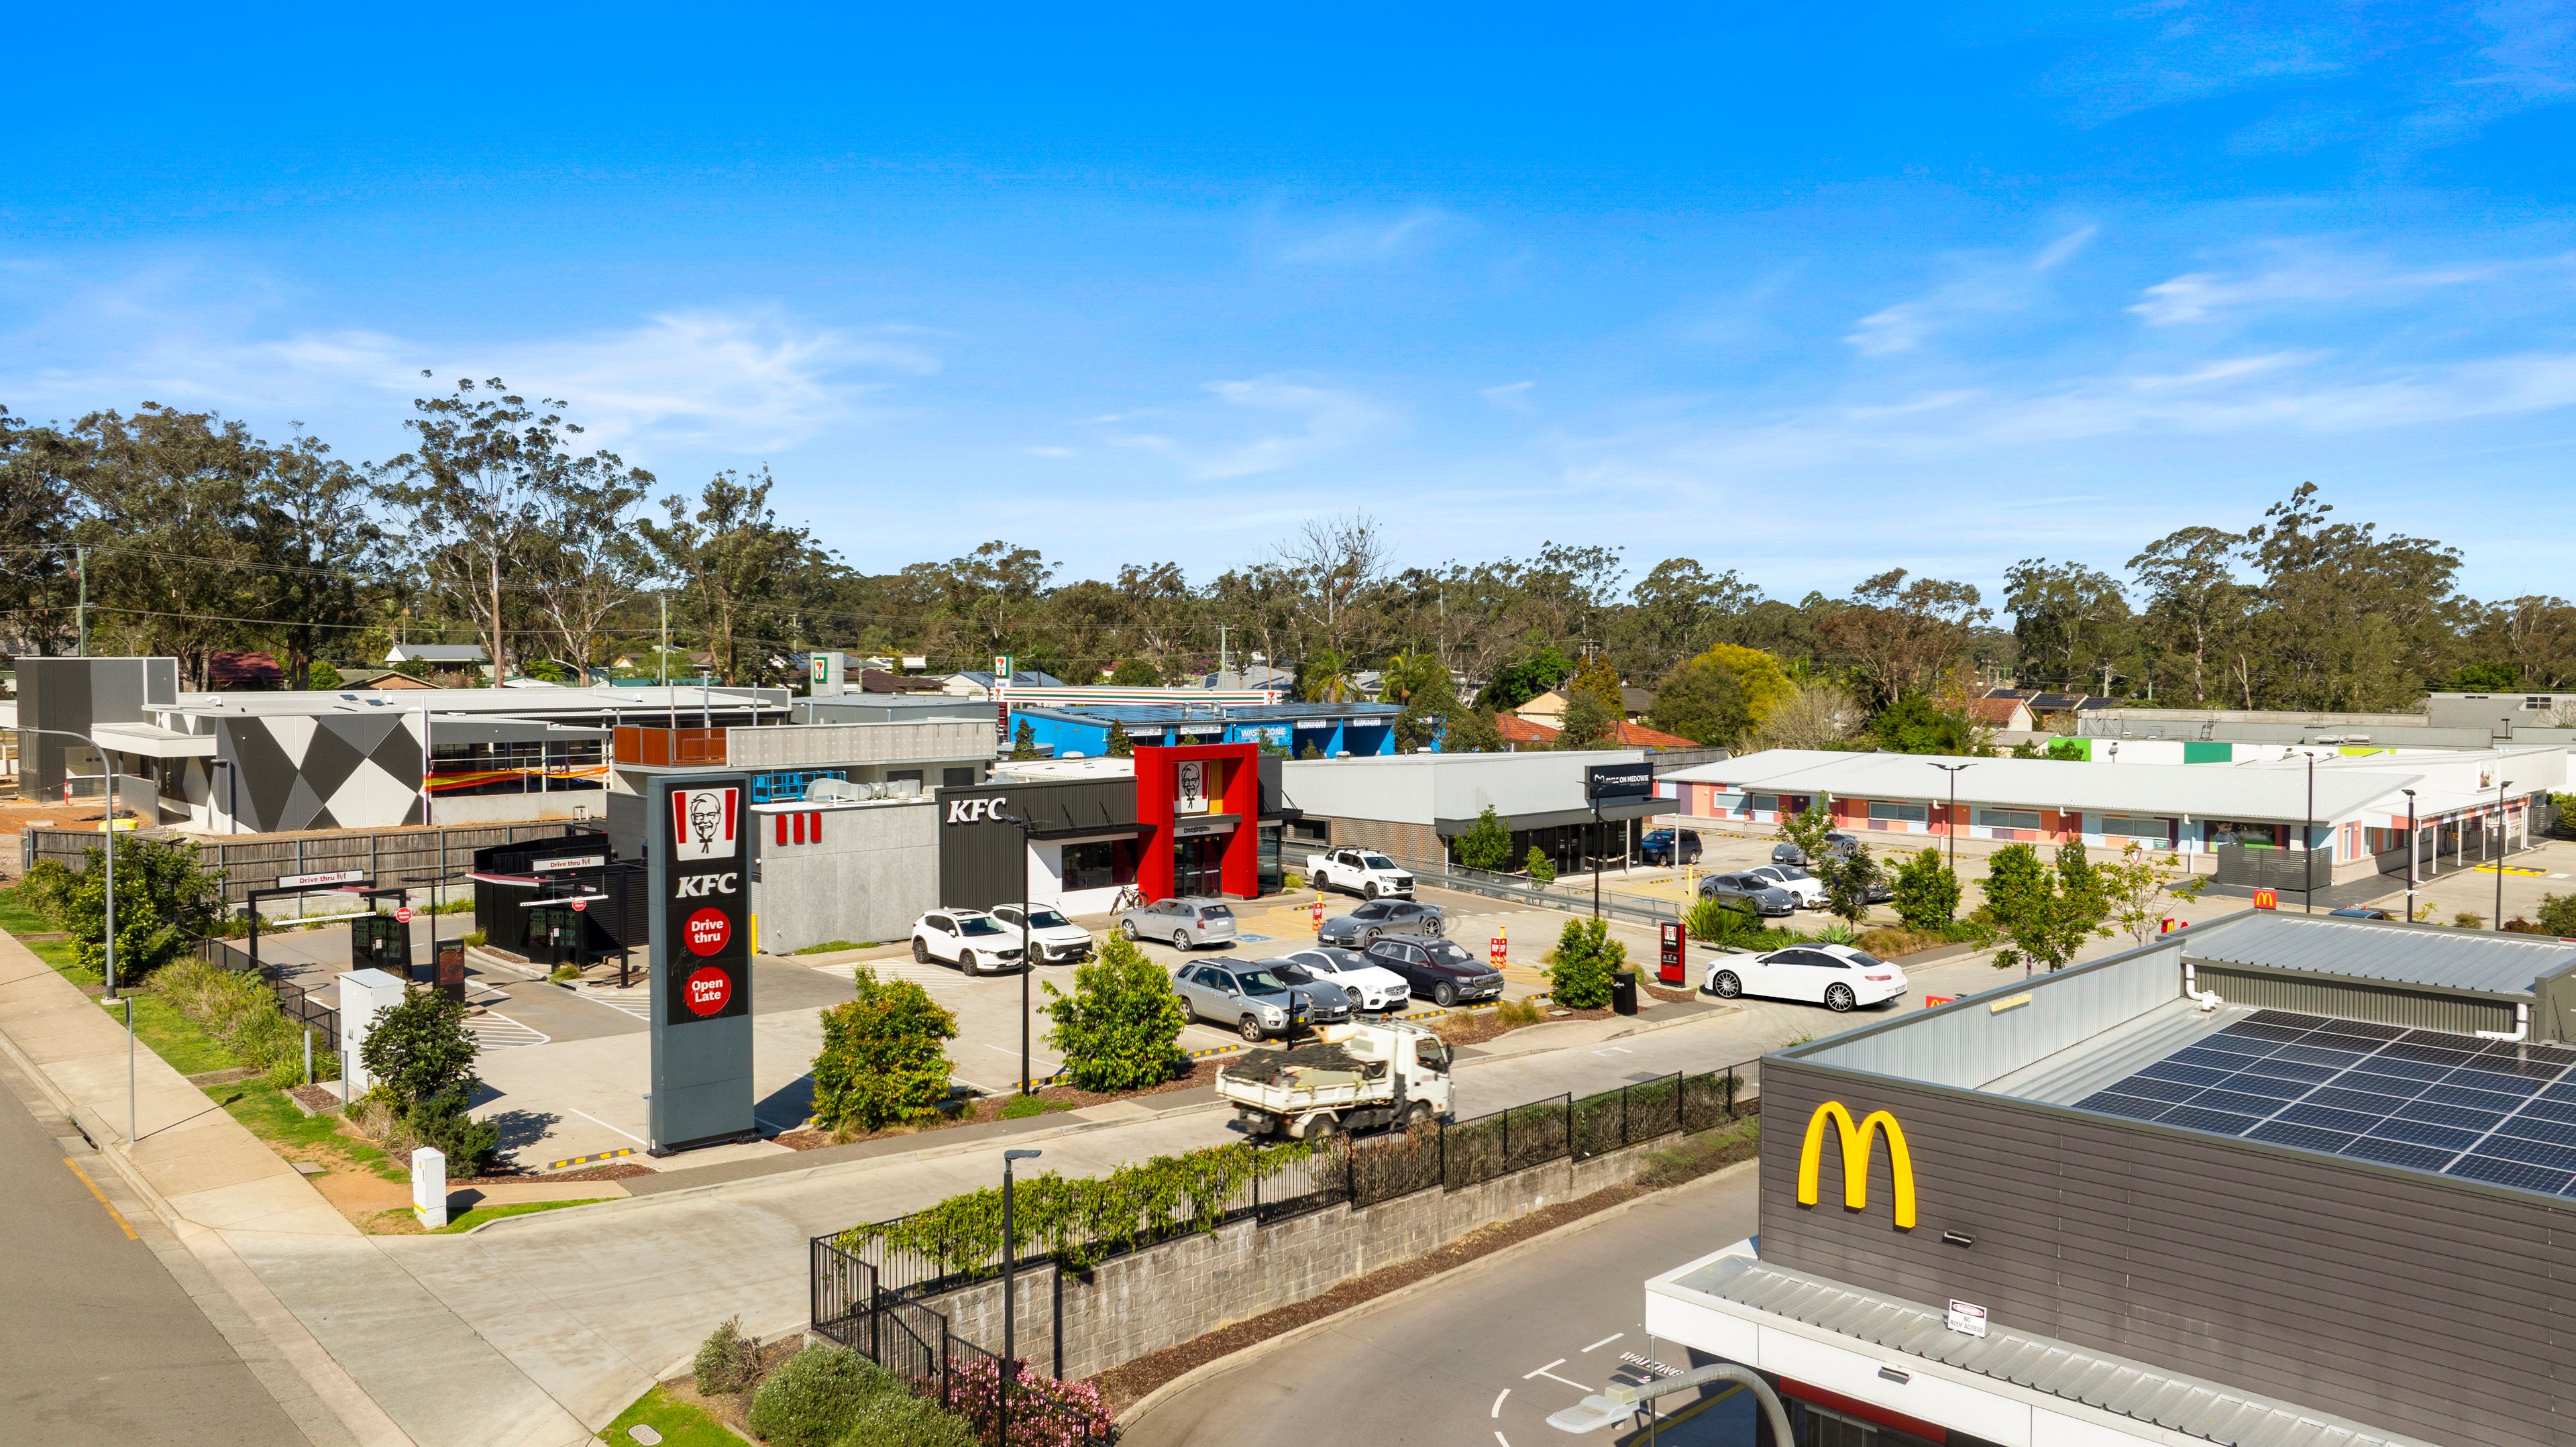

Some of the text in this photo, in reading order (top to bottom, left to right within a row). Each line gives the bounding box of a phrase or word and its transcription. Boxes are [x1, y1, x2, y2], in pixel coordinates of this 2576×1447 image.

[1627, 774, 1649, 782] MEDOWIE
[947, 797, 1006, 823] KFC
[676, 872, 738, 898] KFC
[691, 919, 724, 932] Drive
[694, 930, 721, 944] thru
[691, 979, 724, 993] Open
[695, 989, 722, 1003] Late
[1950, 1320, 1983, 1334] ROOF ACCESS
[1619, 1351, 1685, 1377] WAITING
